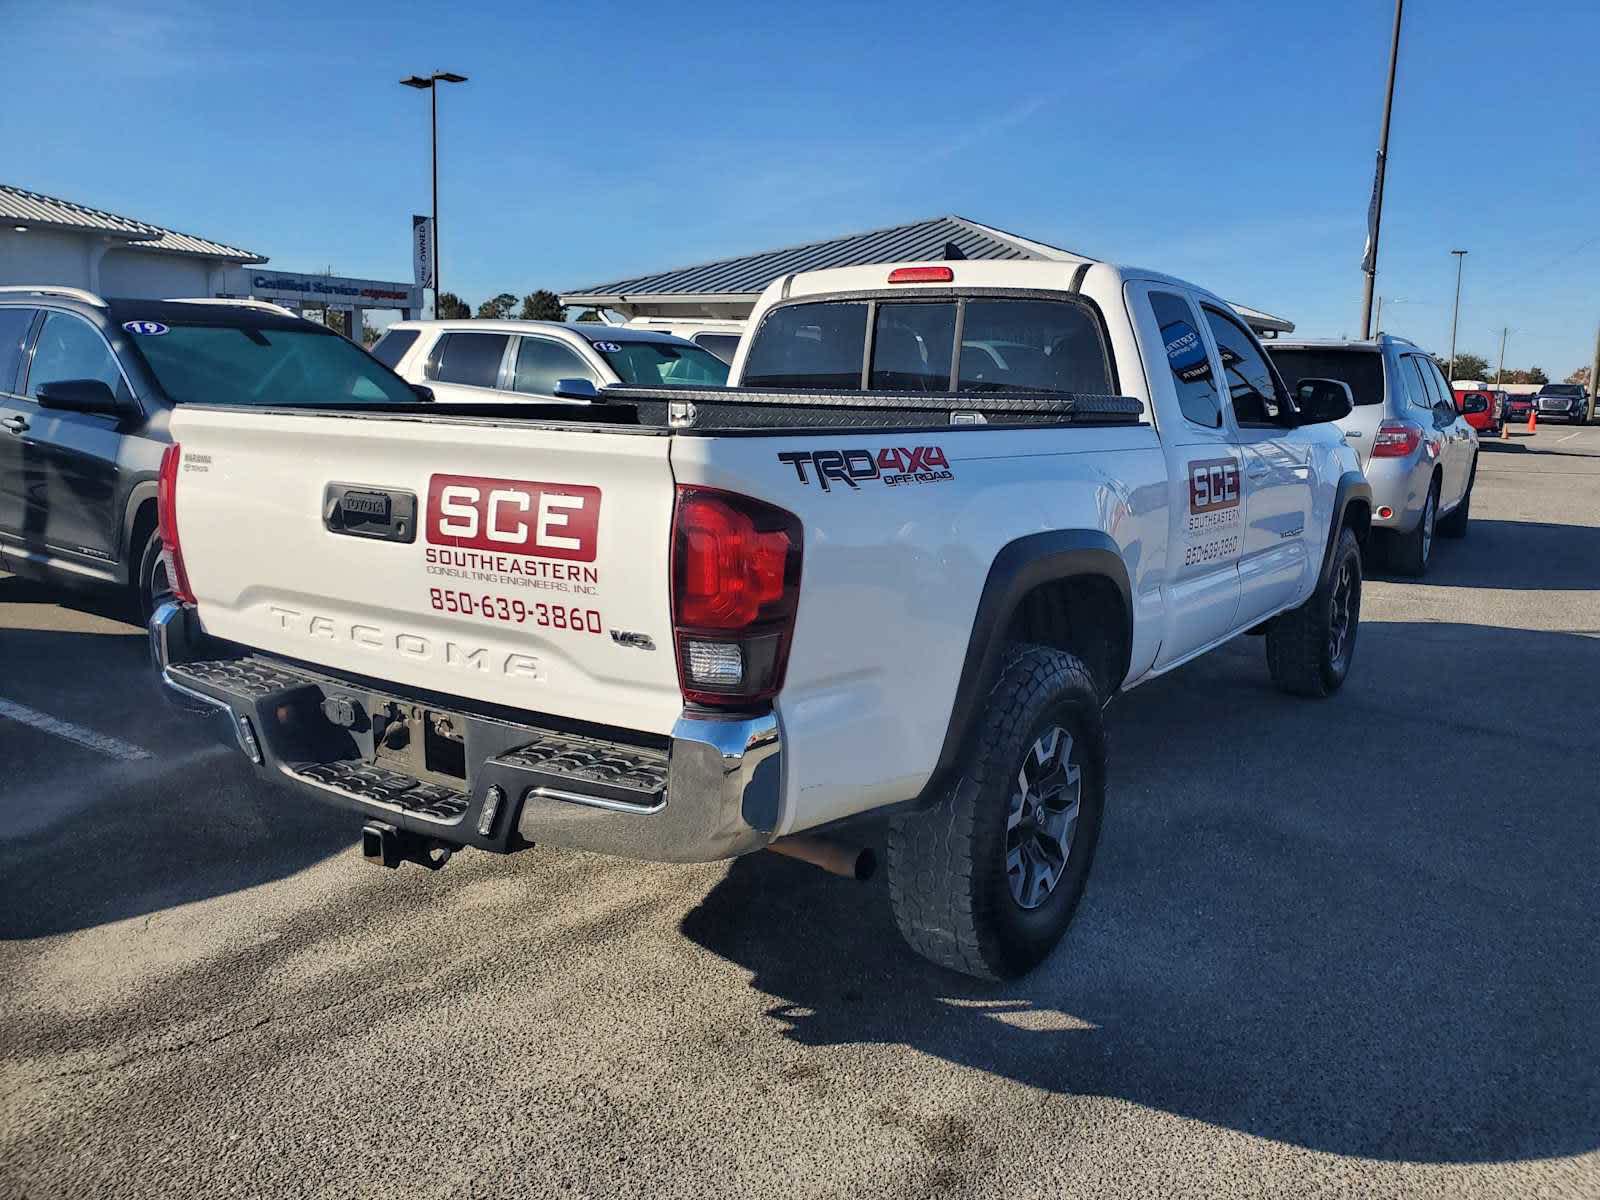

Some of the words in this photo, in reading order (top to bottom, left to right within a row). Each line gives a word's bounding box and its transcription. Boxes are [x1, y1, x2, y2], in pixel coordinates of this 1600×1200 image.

[131, 322, 158, 333] 19
[778, 450, 881, 492] TRD
[883, 474, 914, 487] OFF
[915, 470, 954, 483] ROAD
[1193, 464, 1237, 507] SCE
[345, 498, 385, 513] TOYOTA
[439, 485, 585, 550] SCE
[426, 548, 598, 583] SOUTHEASTERN
[426, 565, 498, 583] CONSULTING
[500, 574, 570, 593] ENGINEERS,
[574, 585, 599, 596] INC.
[430, 588, 602, 633] 850-639-3860
[270, 606, 548, 680] TACOMA
[609, 629, 657, 651] V6
